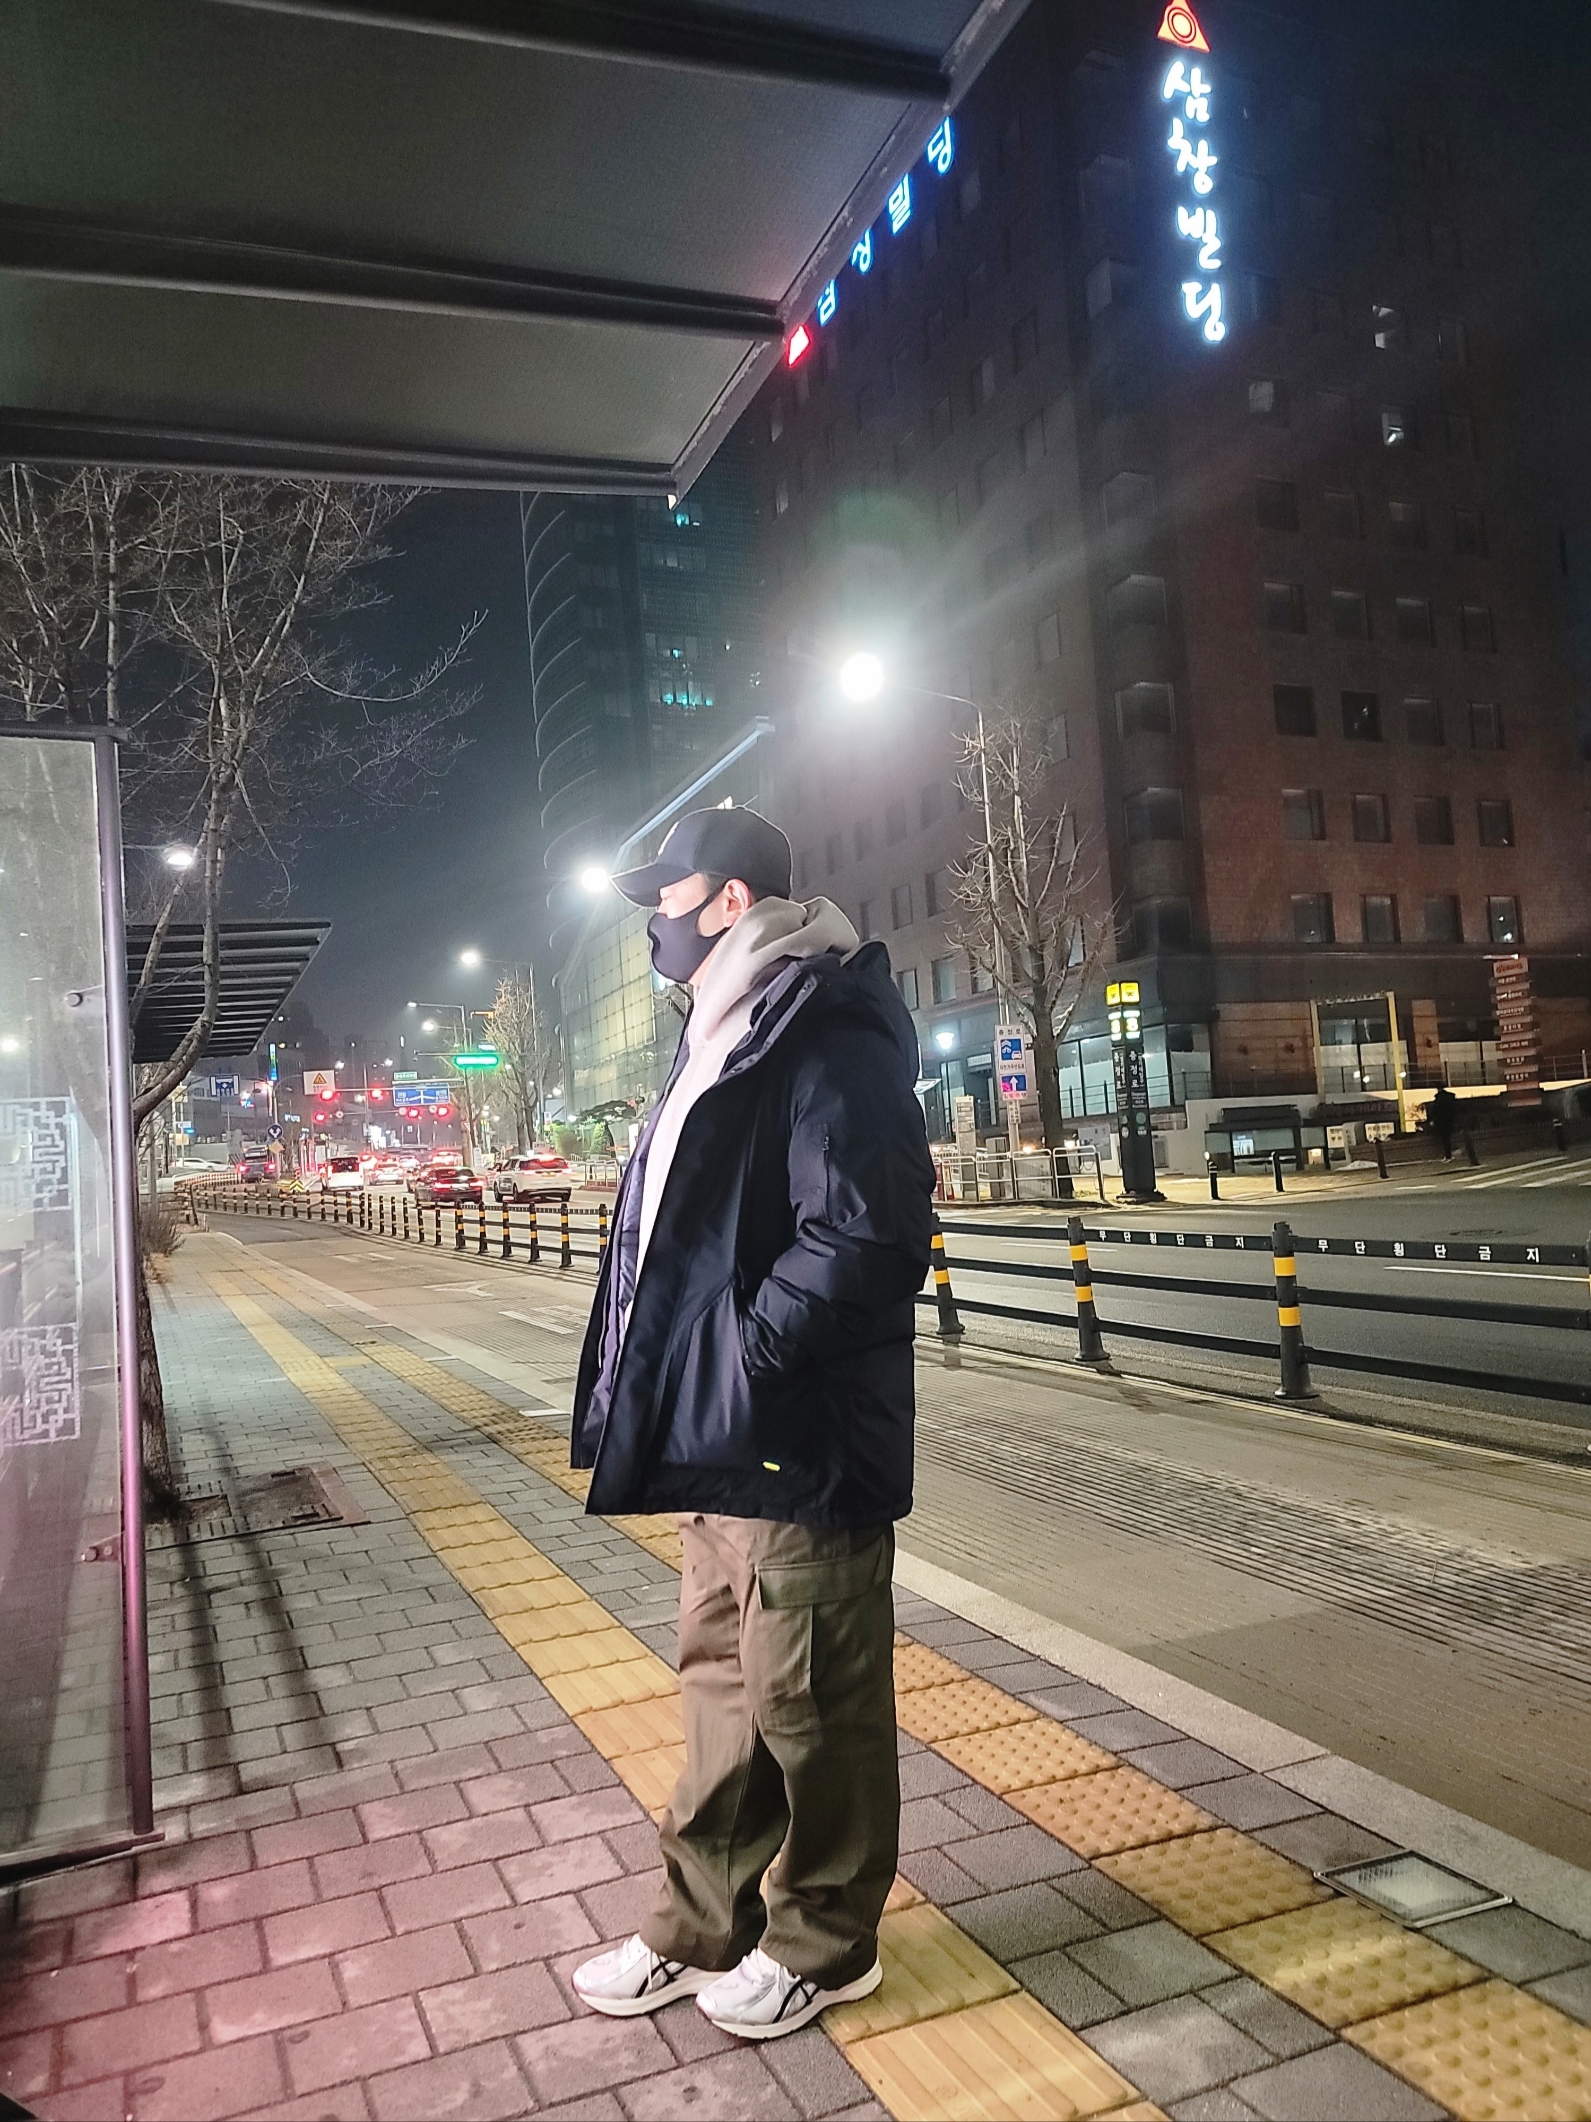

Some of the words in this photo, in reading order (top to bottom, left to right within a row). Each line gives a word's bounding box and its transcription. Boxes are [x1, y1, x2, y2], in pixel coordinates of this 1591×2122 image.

[1162, 60, 1226, 342] 삼창빌딩
[1128, 1050, 1140, 1088] 충정로
[1099, 1230, 1245, 1249] 무단횡단금지
[1317, 1239, 1541, 1263] 무단횡단금지
